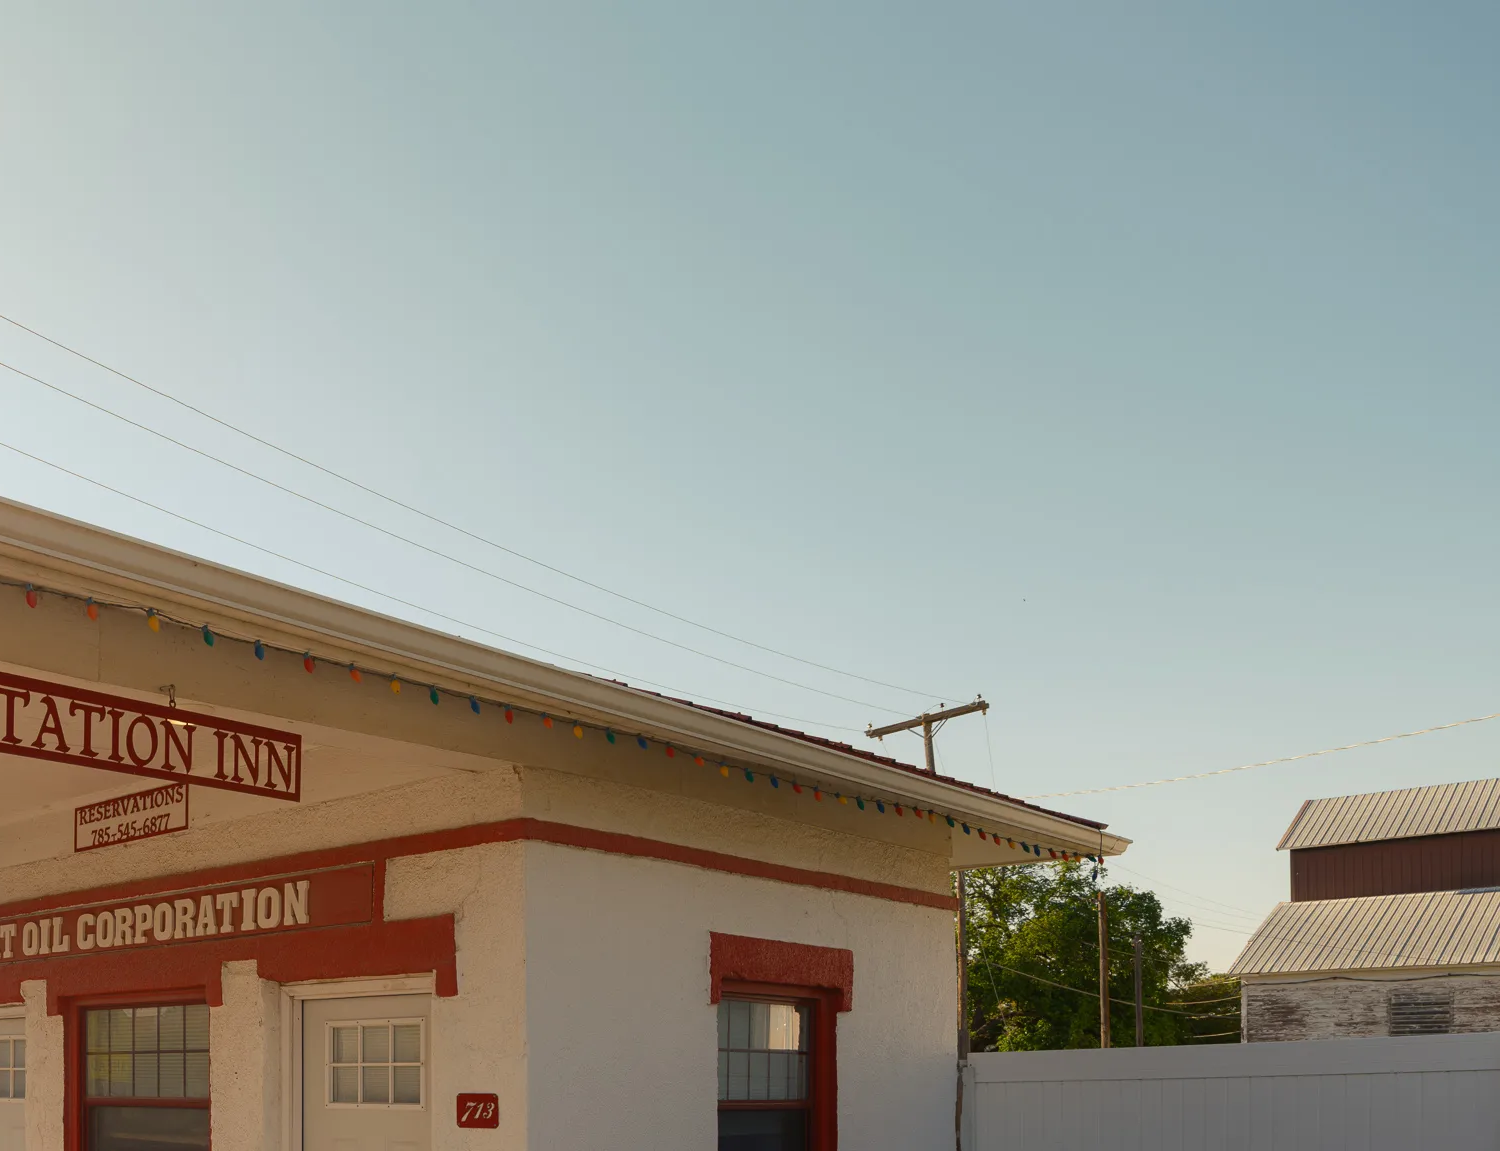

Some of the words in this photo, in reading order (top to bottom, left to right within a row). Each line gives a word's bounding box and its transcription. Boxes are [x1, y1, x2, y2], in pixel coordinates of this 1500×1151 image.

[213, 728, 296, 792] INN
[79, 785, 184, 825] RESERVATIONS
[91, 813, 171, 846] 785-545-6877
[22, 916, 71, 956] OIL
[77, 880, 311, 950] CORPORATION
[461, 1102, 495, 1122] 713
